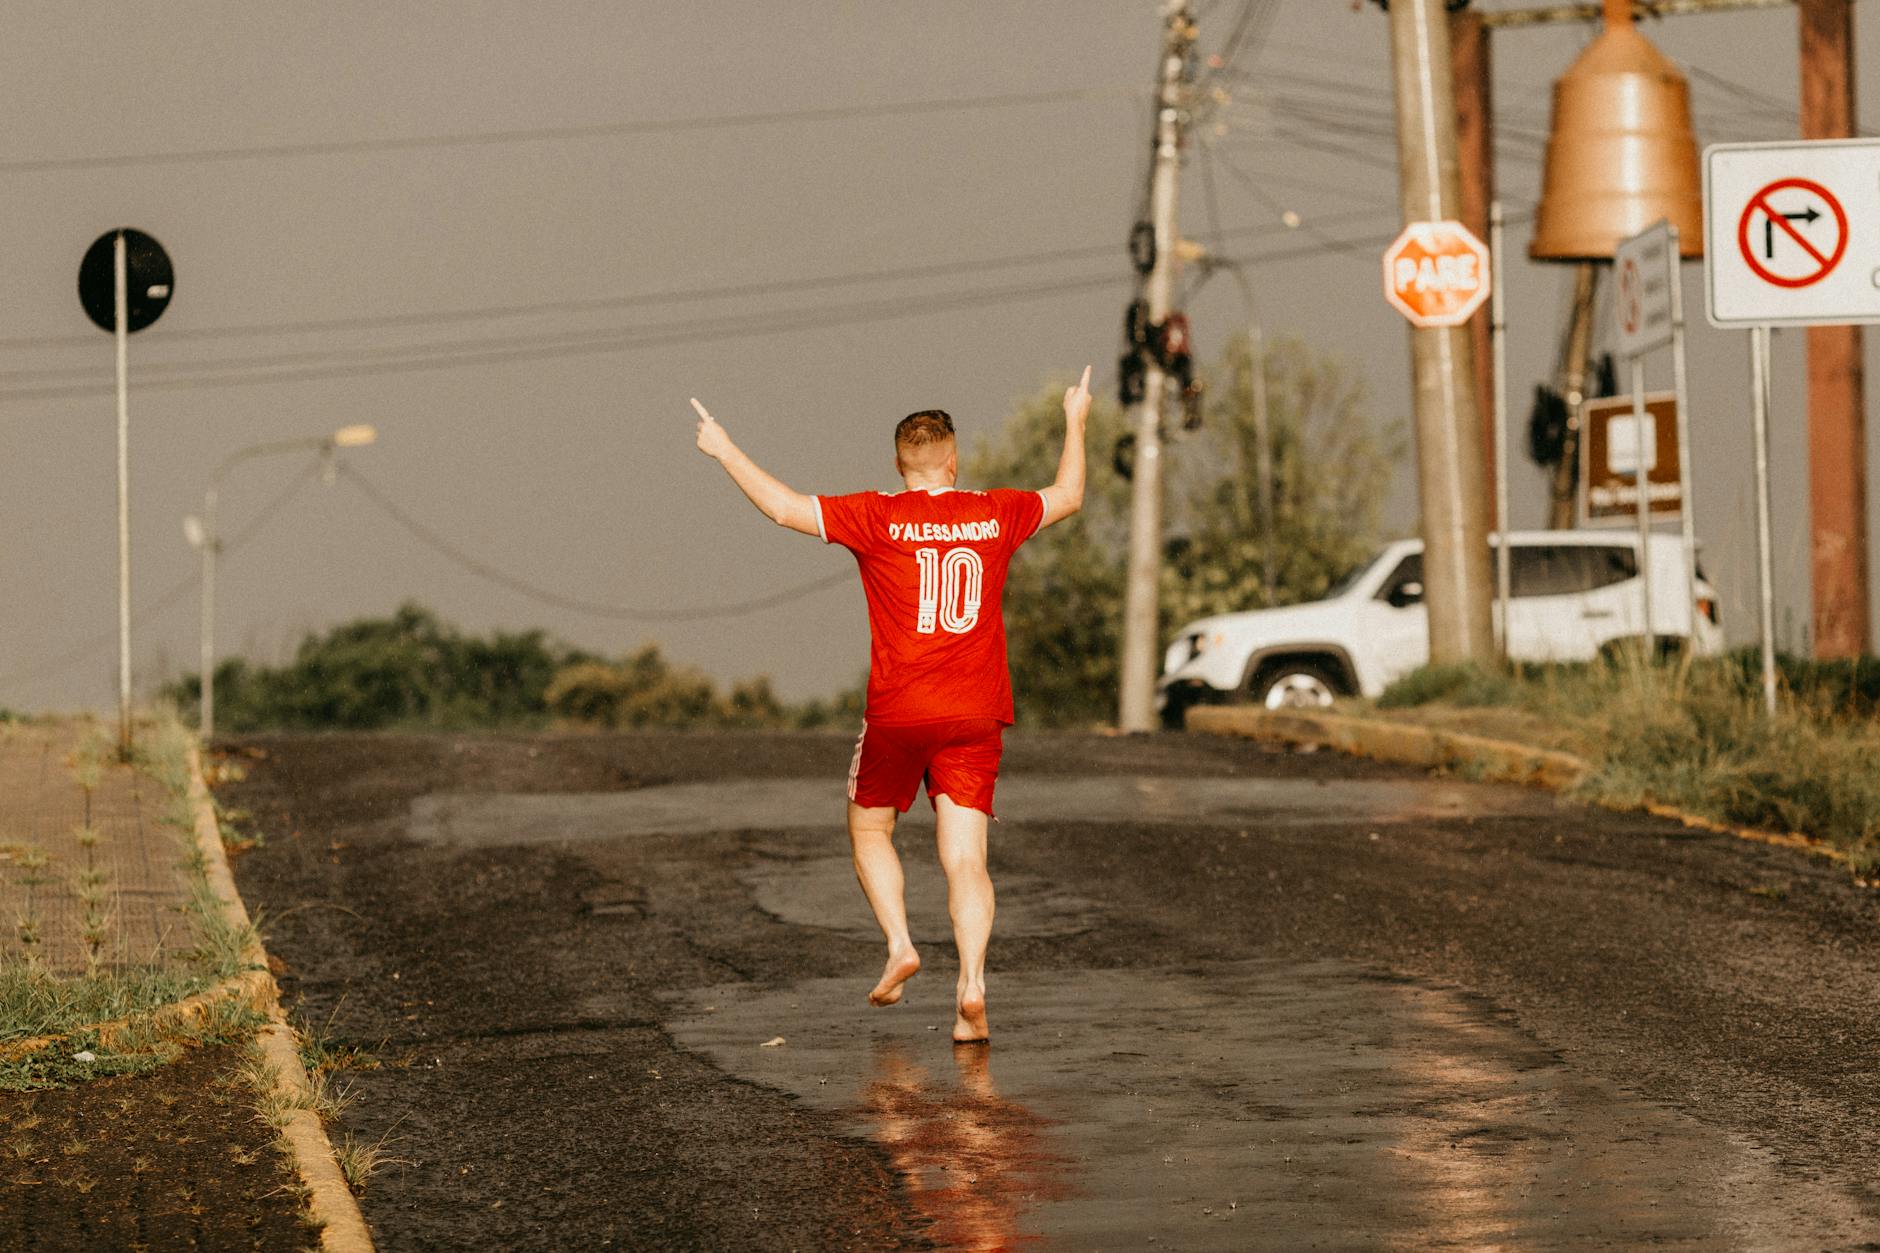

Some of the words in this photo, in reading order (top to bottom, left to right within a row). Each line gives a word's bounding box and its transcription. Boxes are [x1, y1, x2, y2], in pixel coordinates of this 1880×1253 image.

[1395, 253, 1478, 293] PARE
[889, 518, 1000, 541] D'ALESSANDRO
[915, 547, 983, 634] 10
